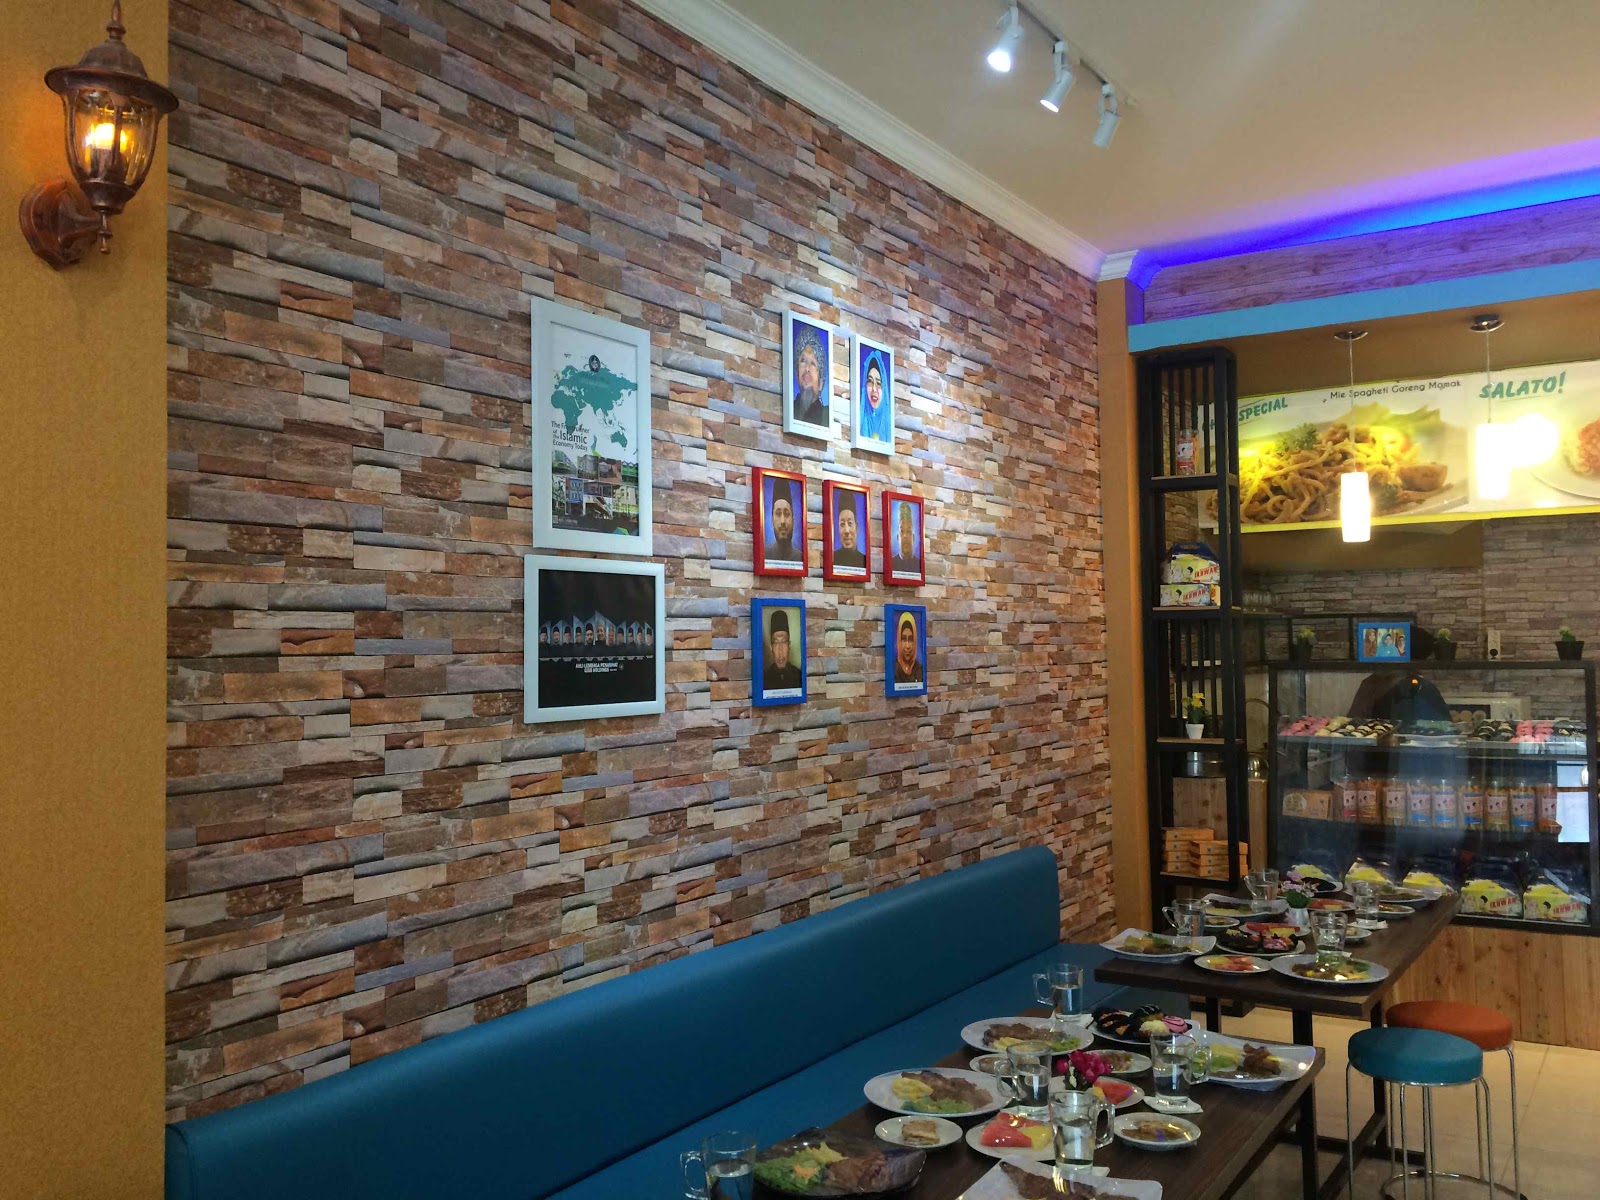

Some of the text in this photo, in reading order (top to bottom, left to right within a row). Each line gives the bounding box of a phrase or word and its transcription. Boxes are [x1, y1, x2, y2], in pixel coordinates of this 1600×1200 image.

[1330, 391, 1346, 399] Mie
[1349, 387, 1389, 399] Spagheti
[1391, 383, 1425, 394] Goreng
[1479, 371, 1566, 399] SALATO!
[1238, 397, 1288, 422] SPECIAL
[560, 430, 587, 444] Islamic
[553, 440, 588, 452] Economy Today
